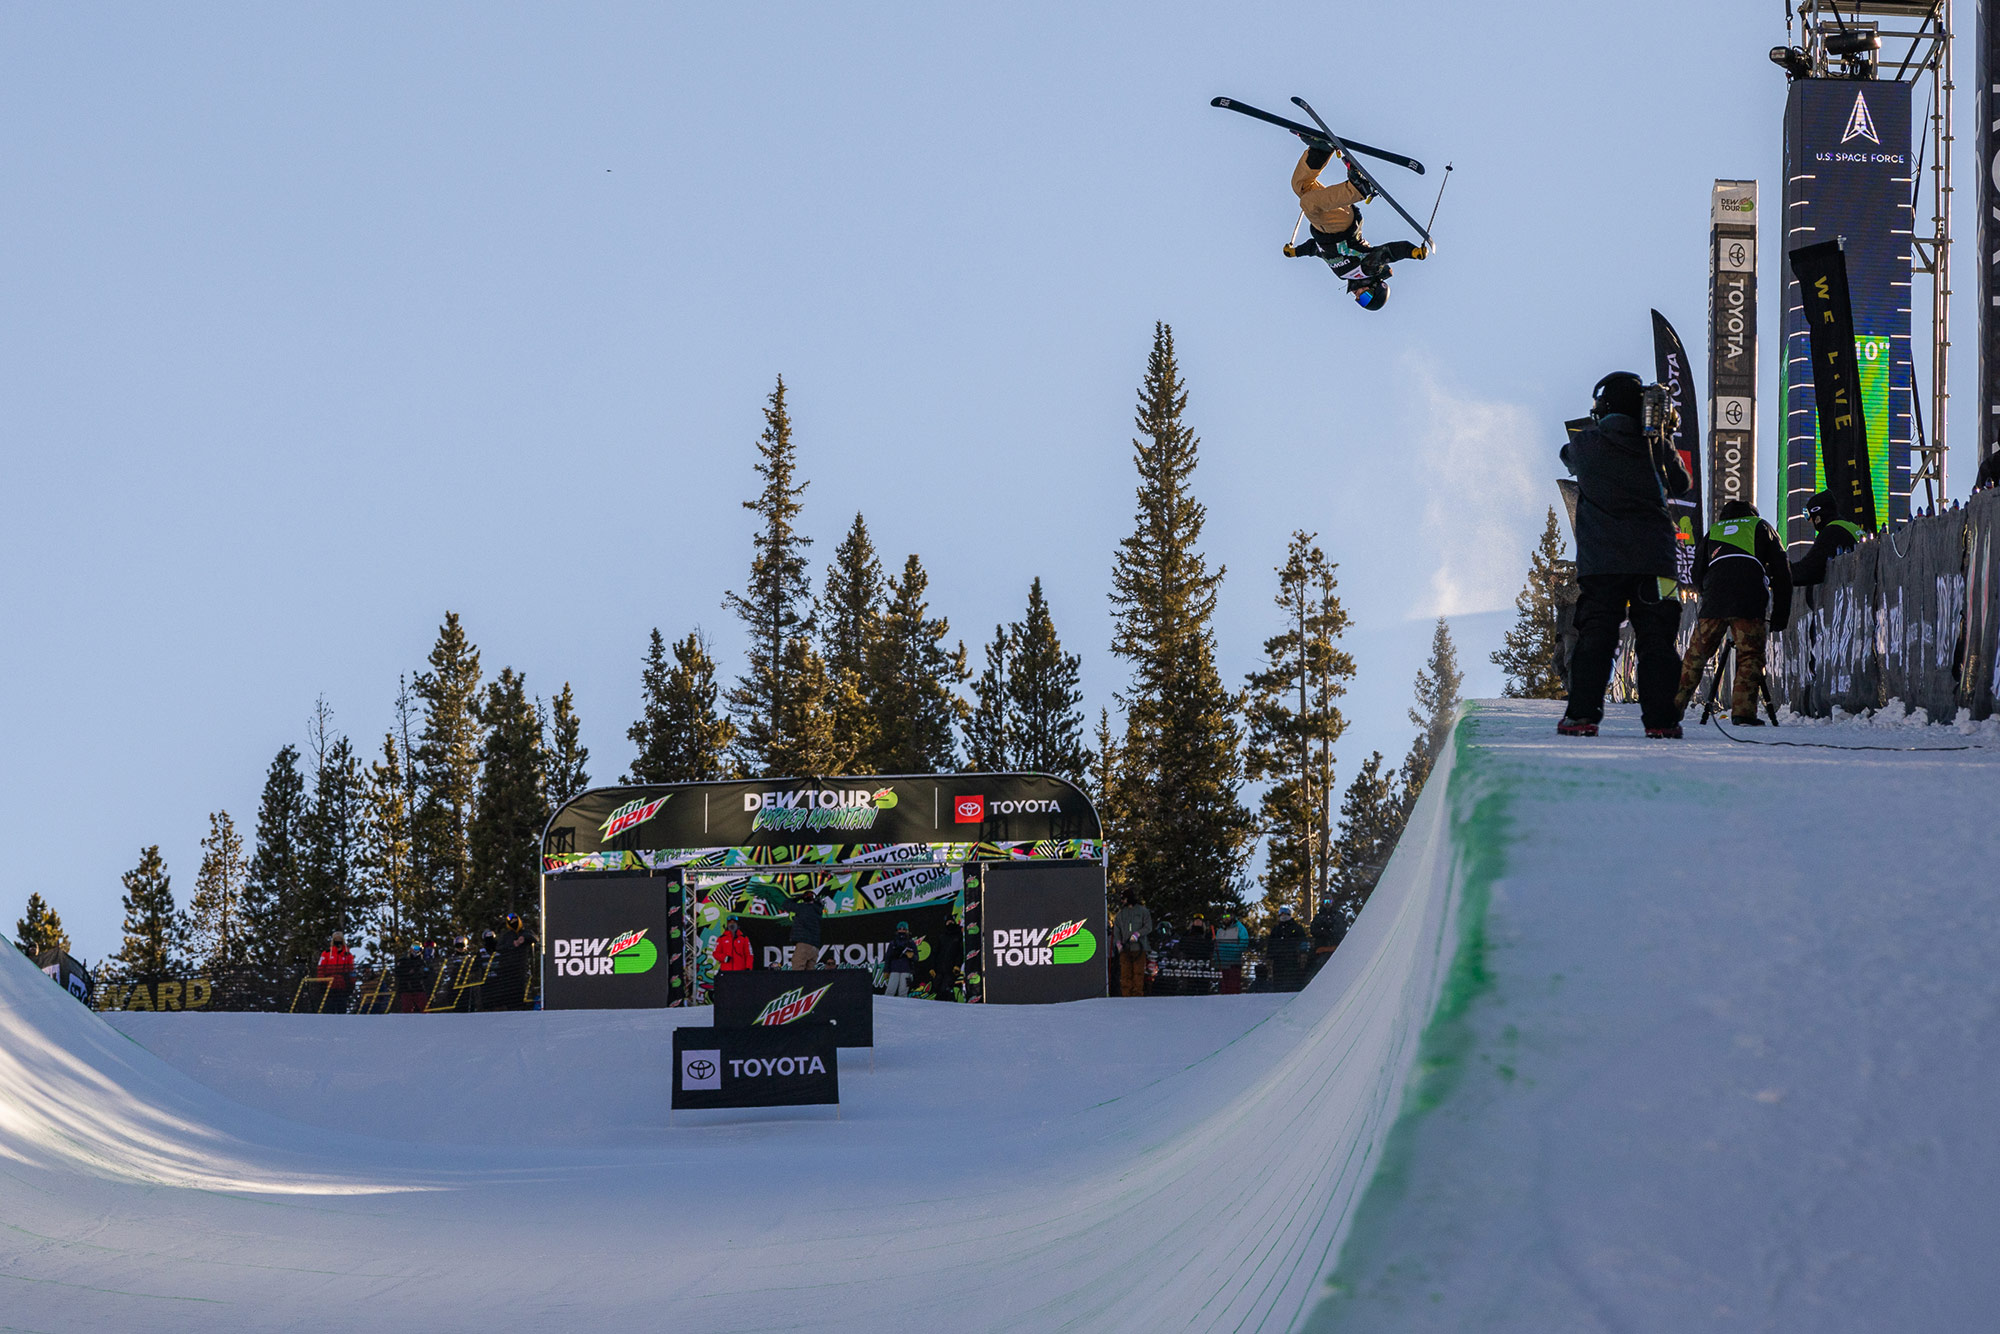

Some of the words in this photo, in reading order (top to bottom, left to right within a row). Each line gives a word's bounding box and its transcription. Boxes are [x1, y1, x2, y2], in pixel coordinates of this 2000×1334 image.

[1816, 152, 1833, 161] U.S.
[1835, 152, 1868, 162] SPACE
[1871, 153, 1905, 164] FORCE
[1728, 278, 1745, 359] TOYOTA
[1666, 353, 1683, 441] TYOTA
[1725, 436, 1741, 502] TOYOT
[990, 800, 1062, 815] TOYOTA
[752, 806, 808, 833] COPPER
[806, 803, 879, 833] MOUNTAIN
[554, 938, 610, 957] DEW
[993, 928, 1049, 947] DEW
[554, 957, 614, 976] TOUR
[993, 947, 1053, 967] TOUR
[729, 1056, 826, 1078] TOYOTA
